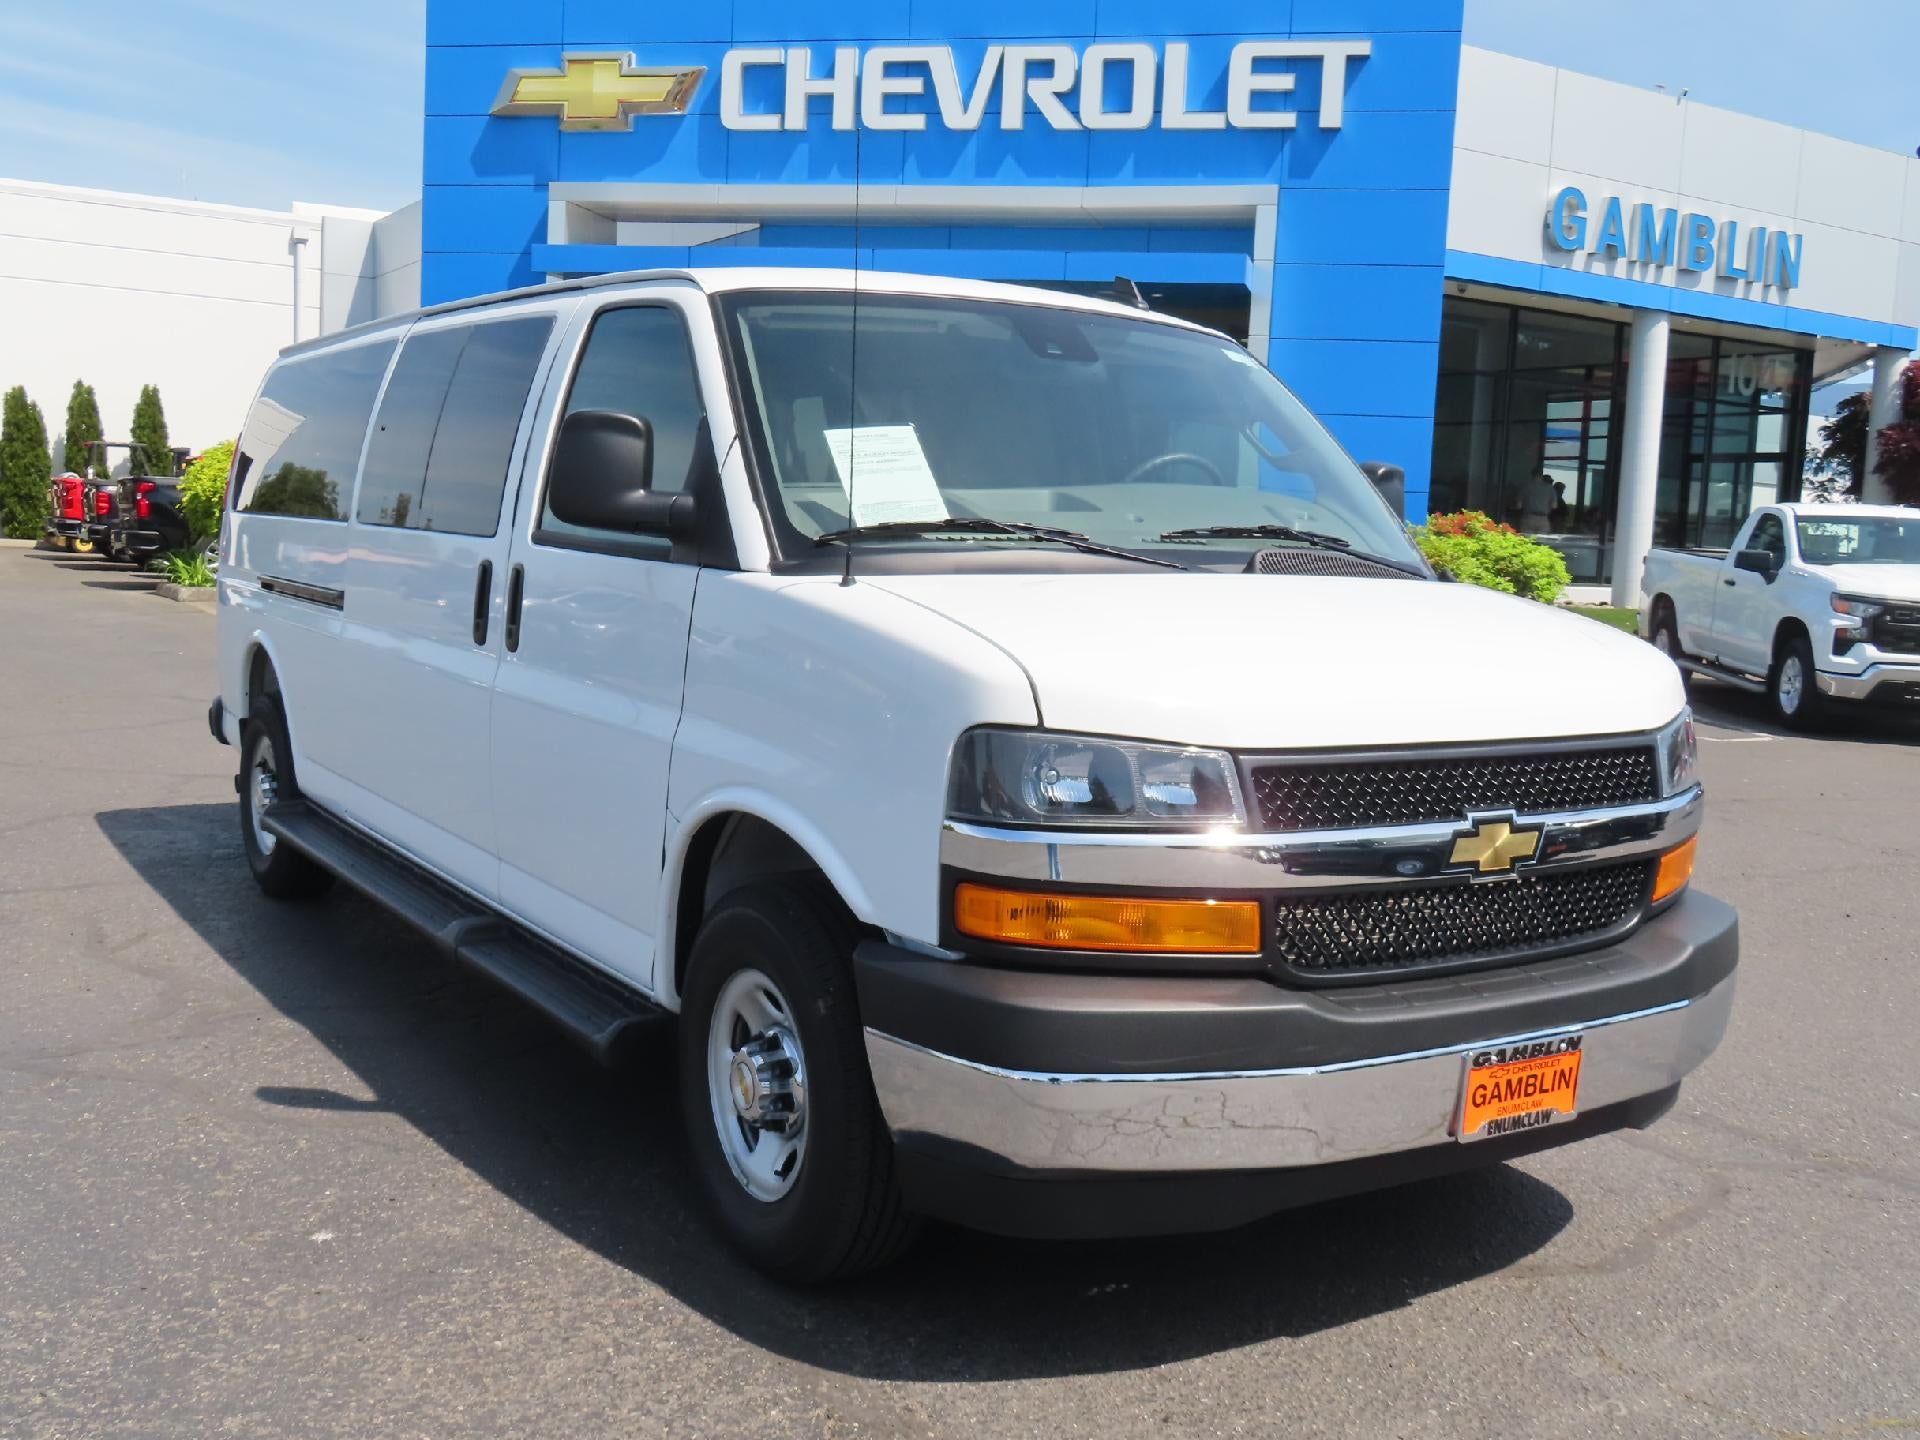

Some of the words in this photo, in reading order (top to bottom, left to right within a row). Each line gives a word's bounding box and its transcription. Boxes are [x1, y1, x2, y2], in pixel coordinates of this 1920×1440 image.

[719, 40, 1372, 132] CHEVROLET
[1546, 186, 1803, 289] GAMBLIN
[1472, 1035, 1583, 1067] GAMBLIN
[1512, 1059, 1561, 1074] CHEVROLET
[1472, 1067, 1573, 1109] GAMBLIN
[1487, 1108, 1552, 1136] ENUMCLAW
[1497, 1098, 1543, 1115] ENUMCLAW
